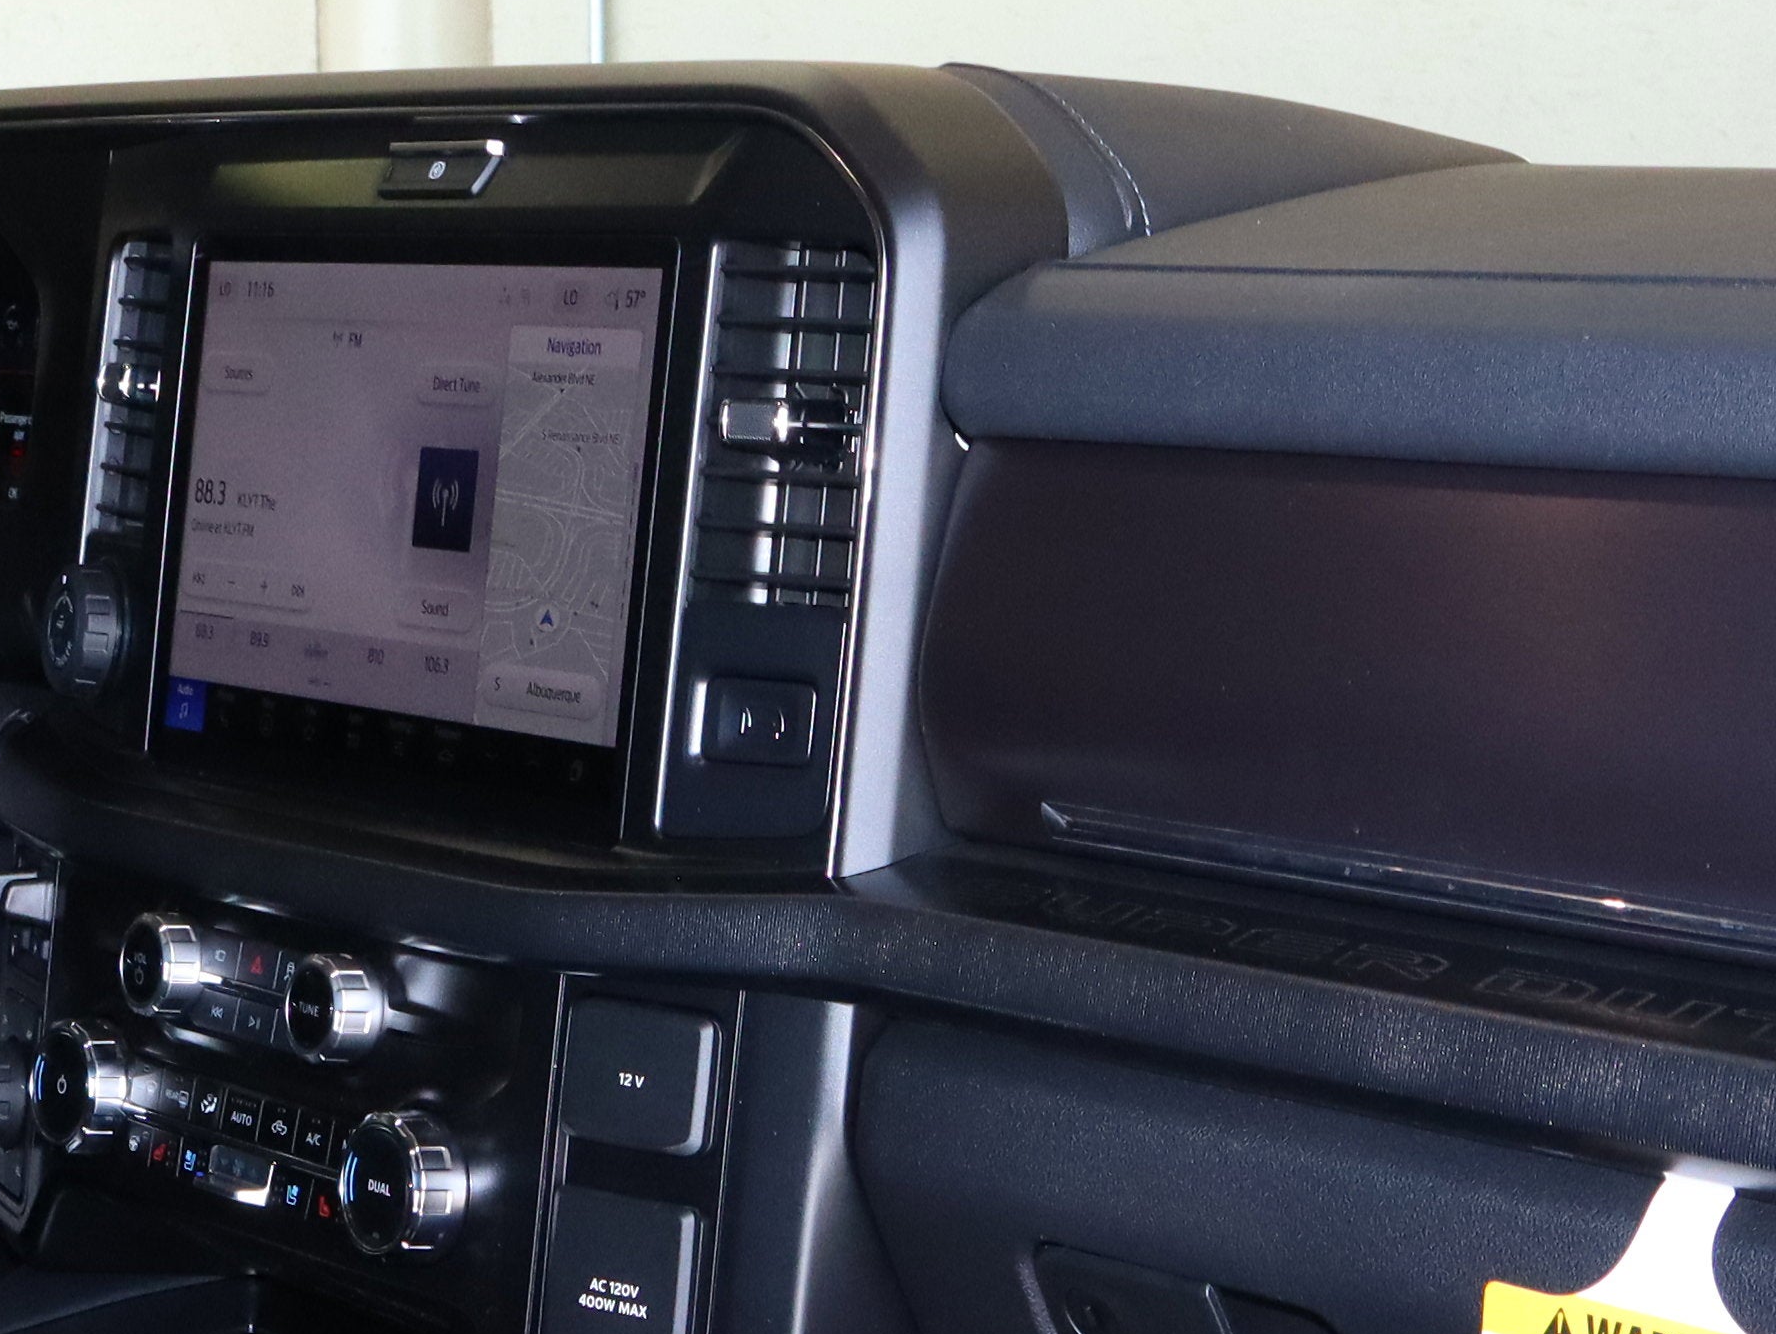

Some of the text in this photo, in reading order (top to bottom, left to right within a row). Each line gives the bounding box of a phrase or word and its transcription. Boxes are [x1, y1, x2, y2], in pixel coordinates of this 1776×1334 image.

[563, 289, 578, 306] LO
[546, 337, 602, 357] Navigation
[432, 376, 481, 393] Direct Tune
[195, 478, 226, 505] 88.3
[422, 599, 449, 616] Sound
[526, 682, 582, 703] Albuquerque
[298, 1001, 320, 1018] TUNE
[618, 1072, 645, 1088] 12 V
[231, 1110, 253, 1127] AUTO
[306, 1132, 321, 1147] A/C
[368, 1178, 391, 1197] DUAL
[589, 1278, 640, 1299] AC 120V
[578, 1293, 648, 1319] 400W MAX
